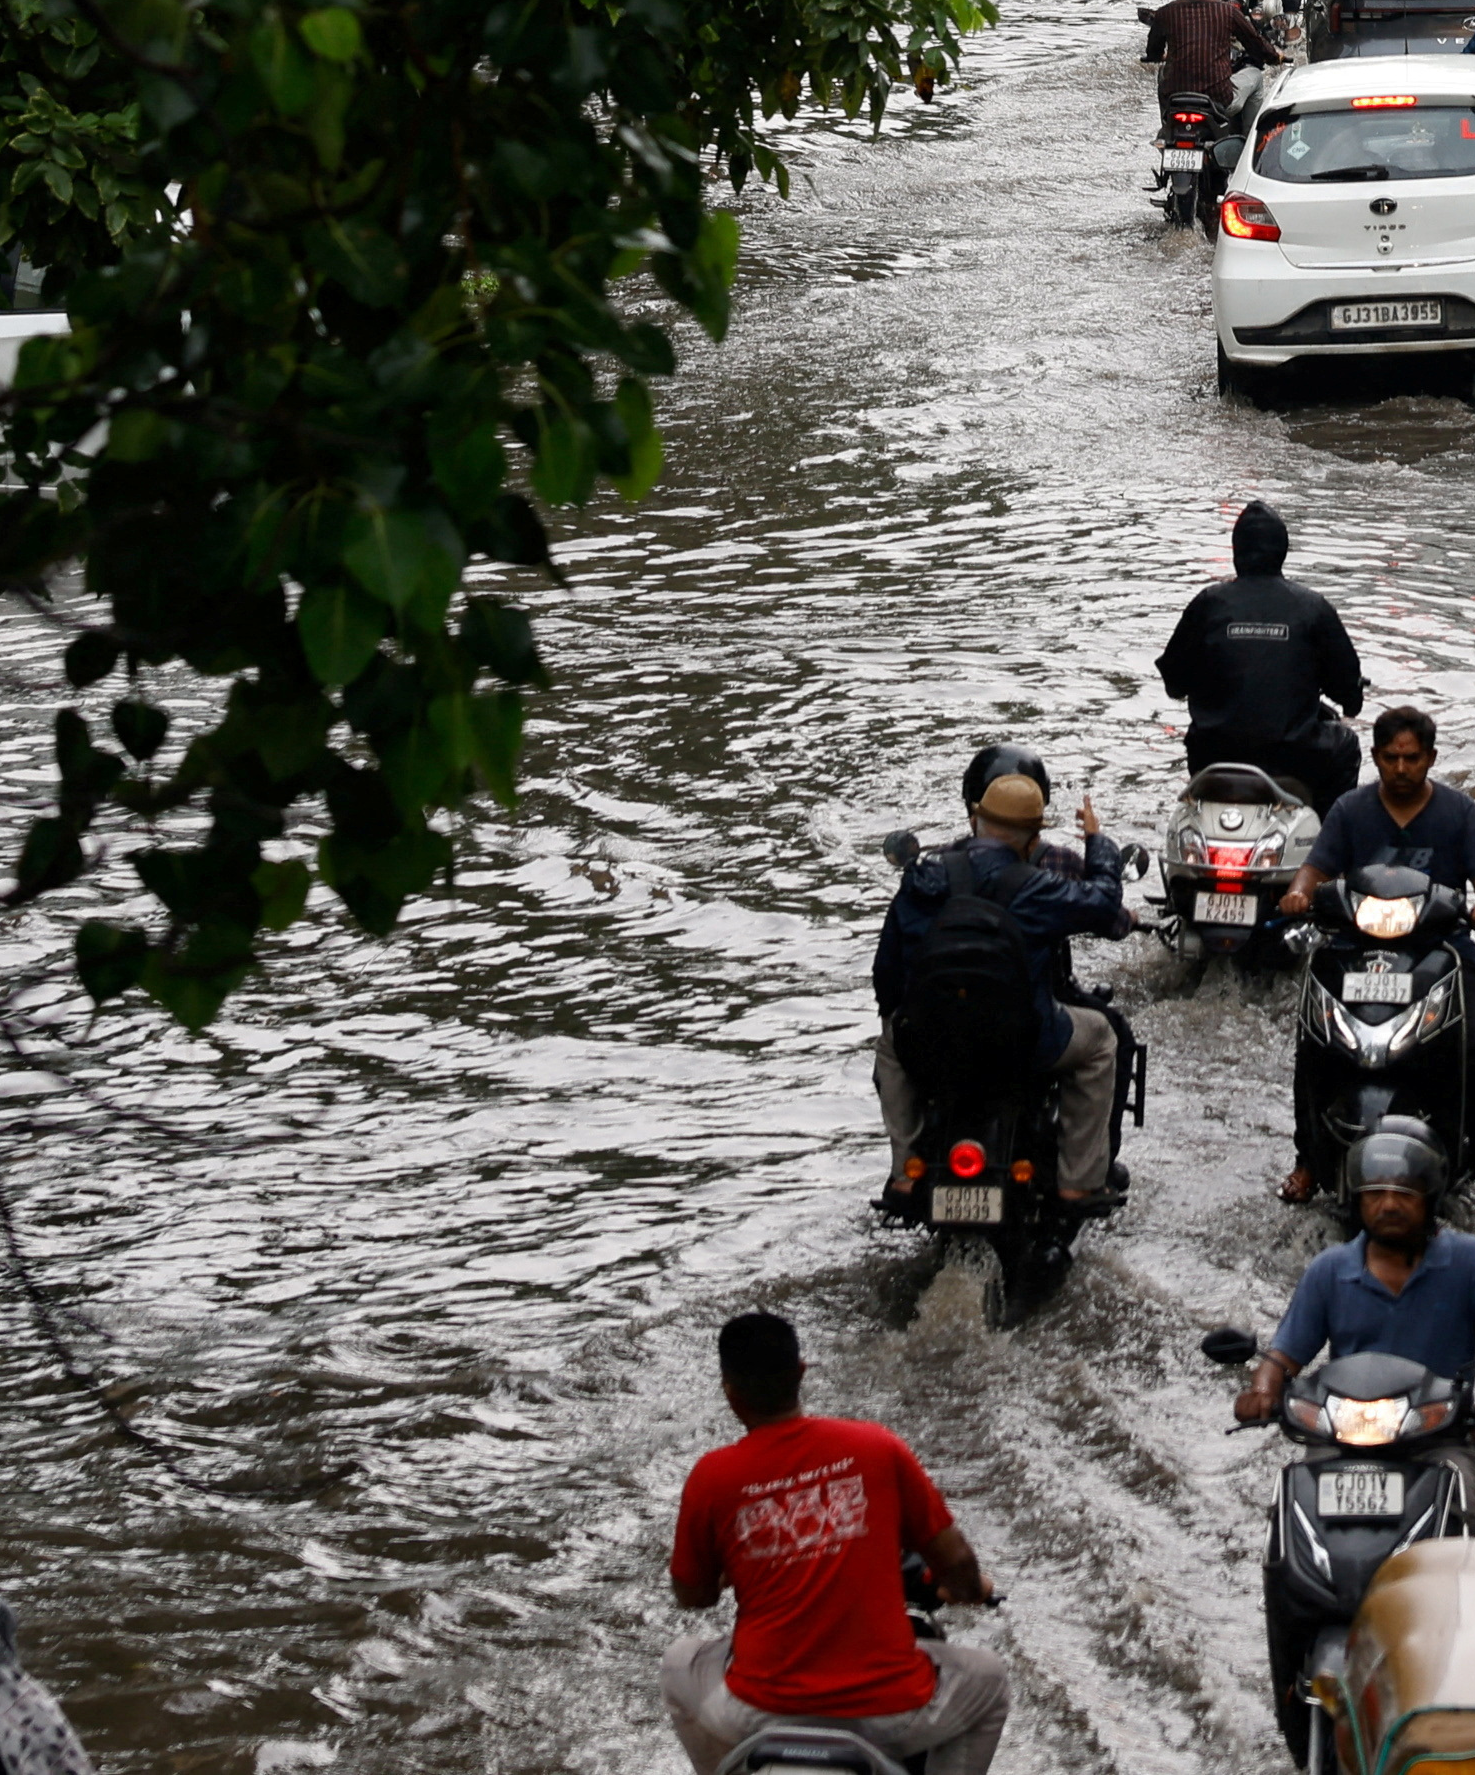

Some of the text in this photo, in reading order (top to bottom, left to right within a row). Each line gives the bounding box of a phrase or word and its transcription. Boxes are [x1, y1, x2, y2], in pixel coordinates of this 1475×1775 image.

[1342, 304, 1439, 324] GJ31BA3955
[1205, 907, 1245, 921] K2459
[1335, 1474, 1387, 1491] GJ01V
